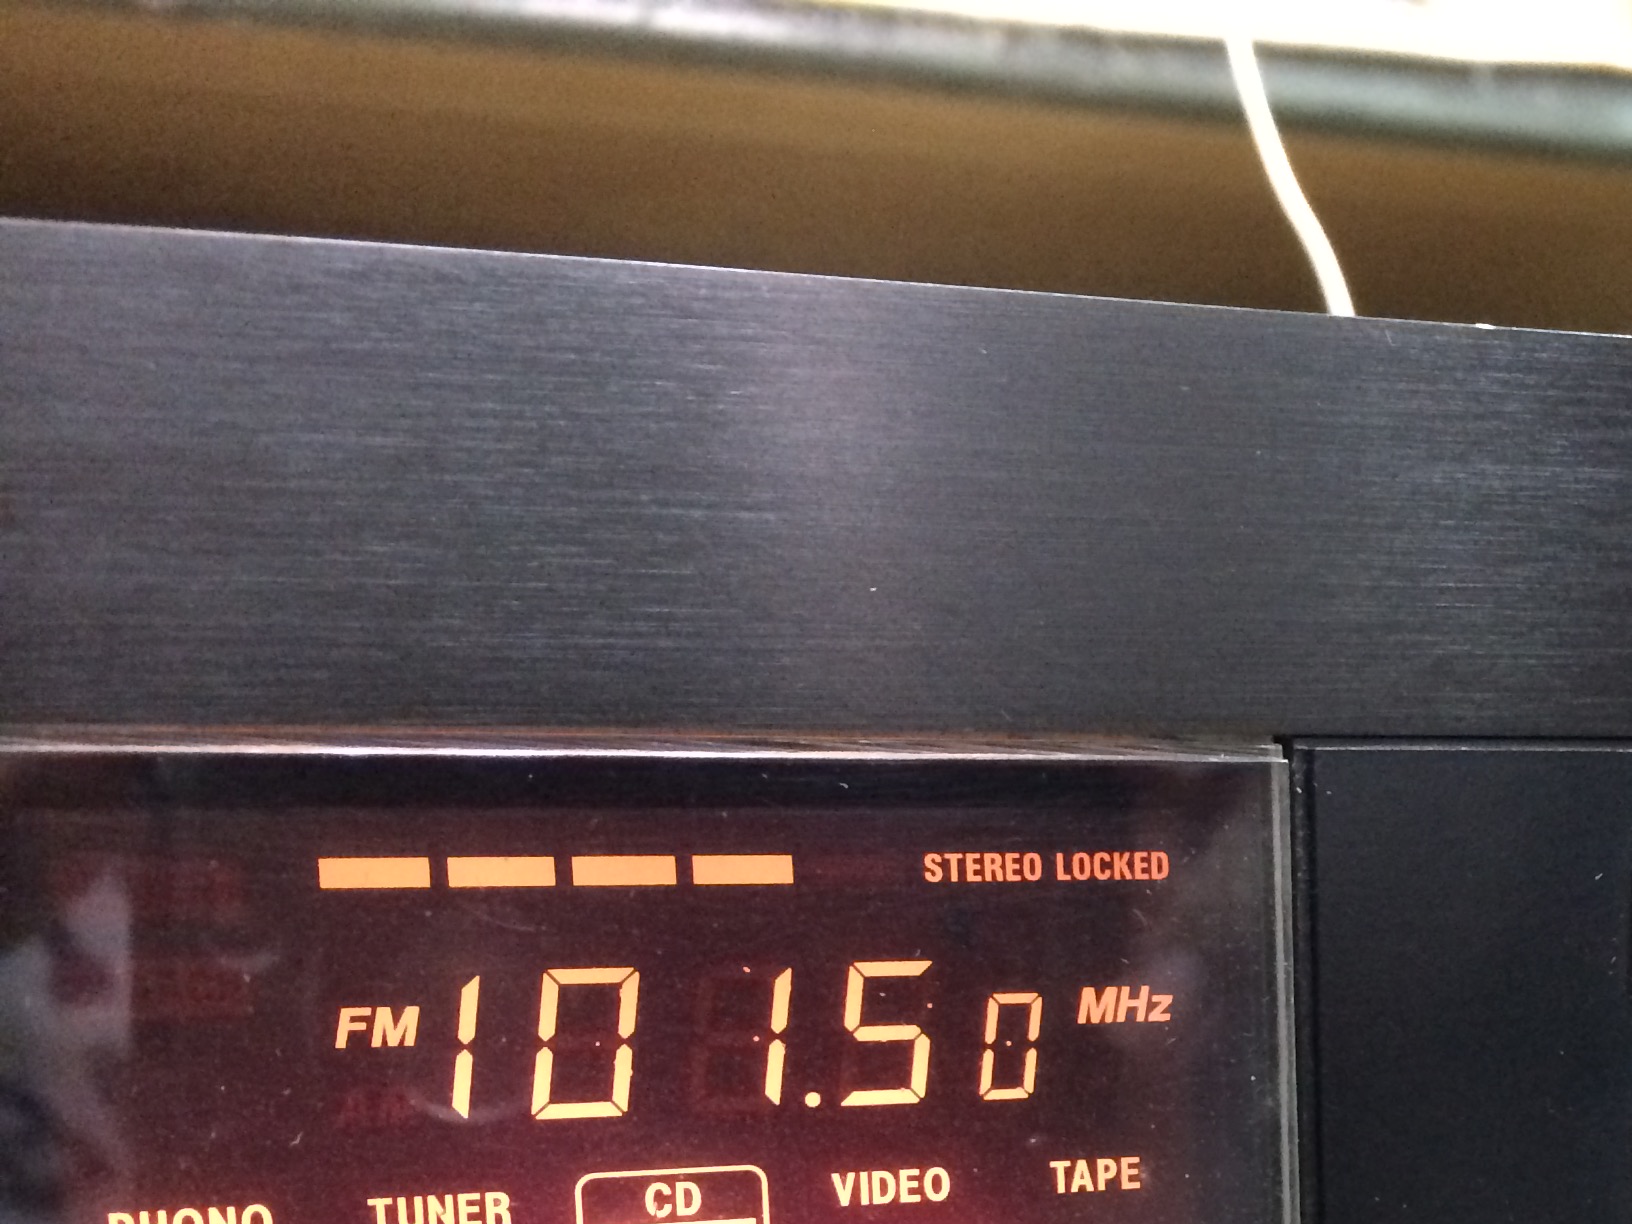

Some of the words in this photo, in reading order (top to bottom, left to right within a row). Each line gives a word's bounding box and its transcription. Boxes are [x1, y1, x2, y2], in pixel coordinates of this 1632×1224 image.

[923, 852, 1042, 883] STEREO
[1056, 851, 1169, 881] LOCKED
[334, 1005, 420, 1049] FM
[1077, 984, 1174, 1025] MHz
[830, 1166, 951, 1207] VIDEO
[1049, 1156, 1141, 1194] TAPE
[644, 1181, 703, 1219] CD
